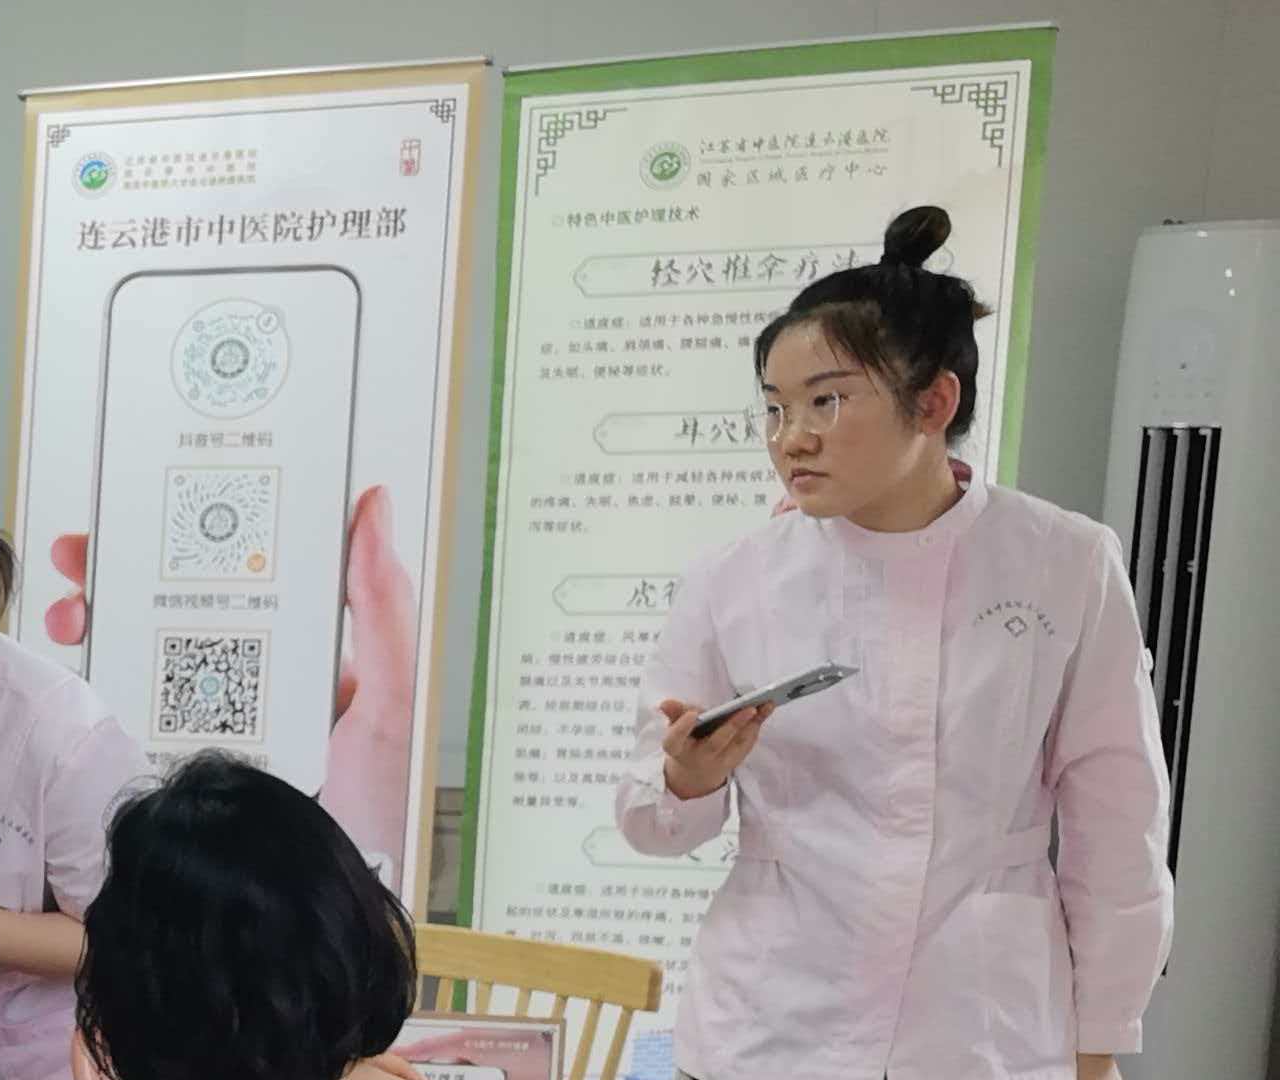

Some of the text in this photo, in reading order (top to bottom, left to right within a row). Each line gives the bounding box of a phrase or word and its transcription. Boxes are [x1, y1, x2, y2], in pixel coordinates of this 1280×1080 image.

[77, 205, 407, 251] 连云港市中医院护理部
